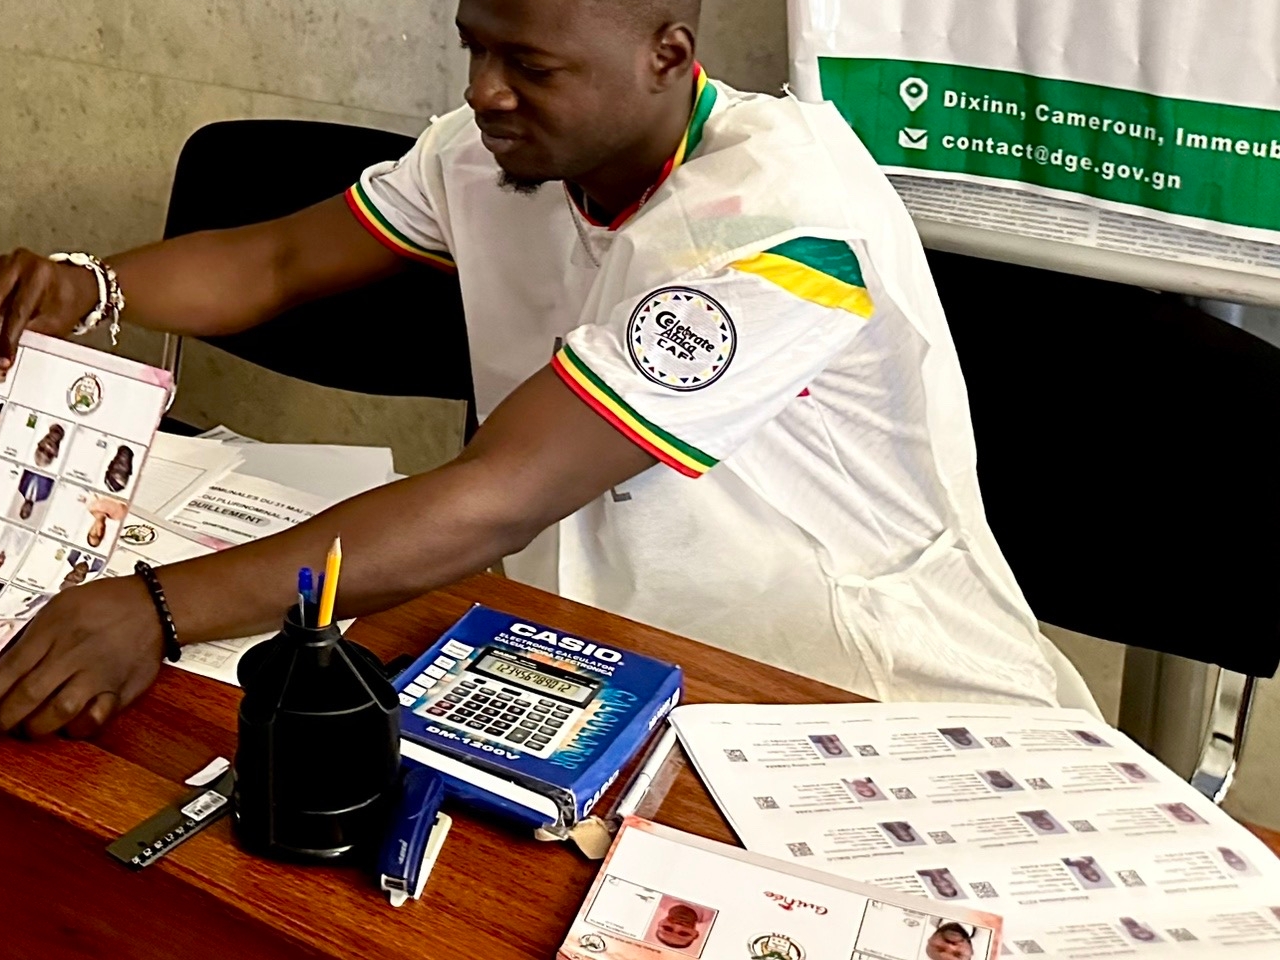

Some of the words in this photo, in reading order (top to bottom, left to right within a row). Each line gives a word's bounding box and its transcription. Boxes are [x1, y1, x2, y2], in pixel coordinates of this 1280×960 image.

[942, 89, 1026, 121] Dixinn,
[1034, 103, 1166, 146] Cameroun,
[941, 131, 1182, 192] contact@dge.gov.gn
[656, 310, 716, 353] Celebrate
[656, 328, 698, 357] Africa
[656, 338, 691, 361] CAF
[286, 505, 304, 515] MAI
[498, 632, 555, 653] ELECTRONIC
[555, 649, 616, 672] CALCULATOR
[509, 622, 623, 664] CASIO
[425, 725, 521, 761] DM-1200V
